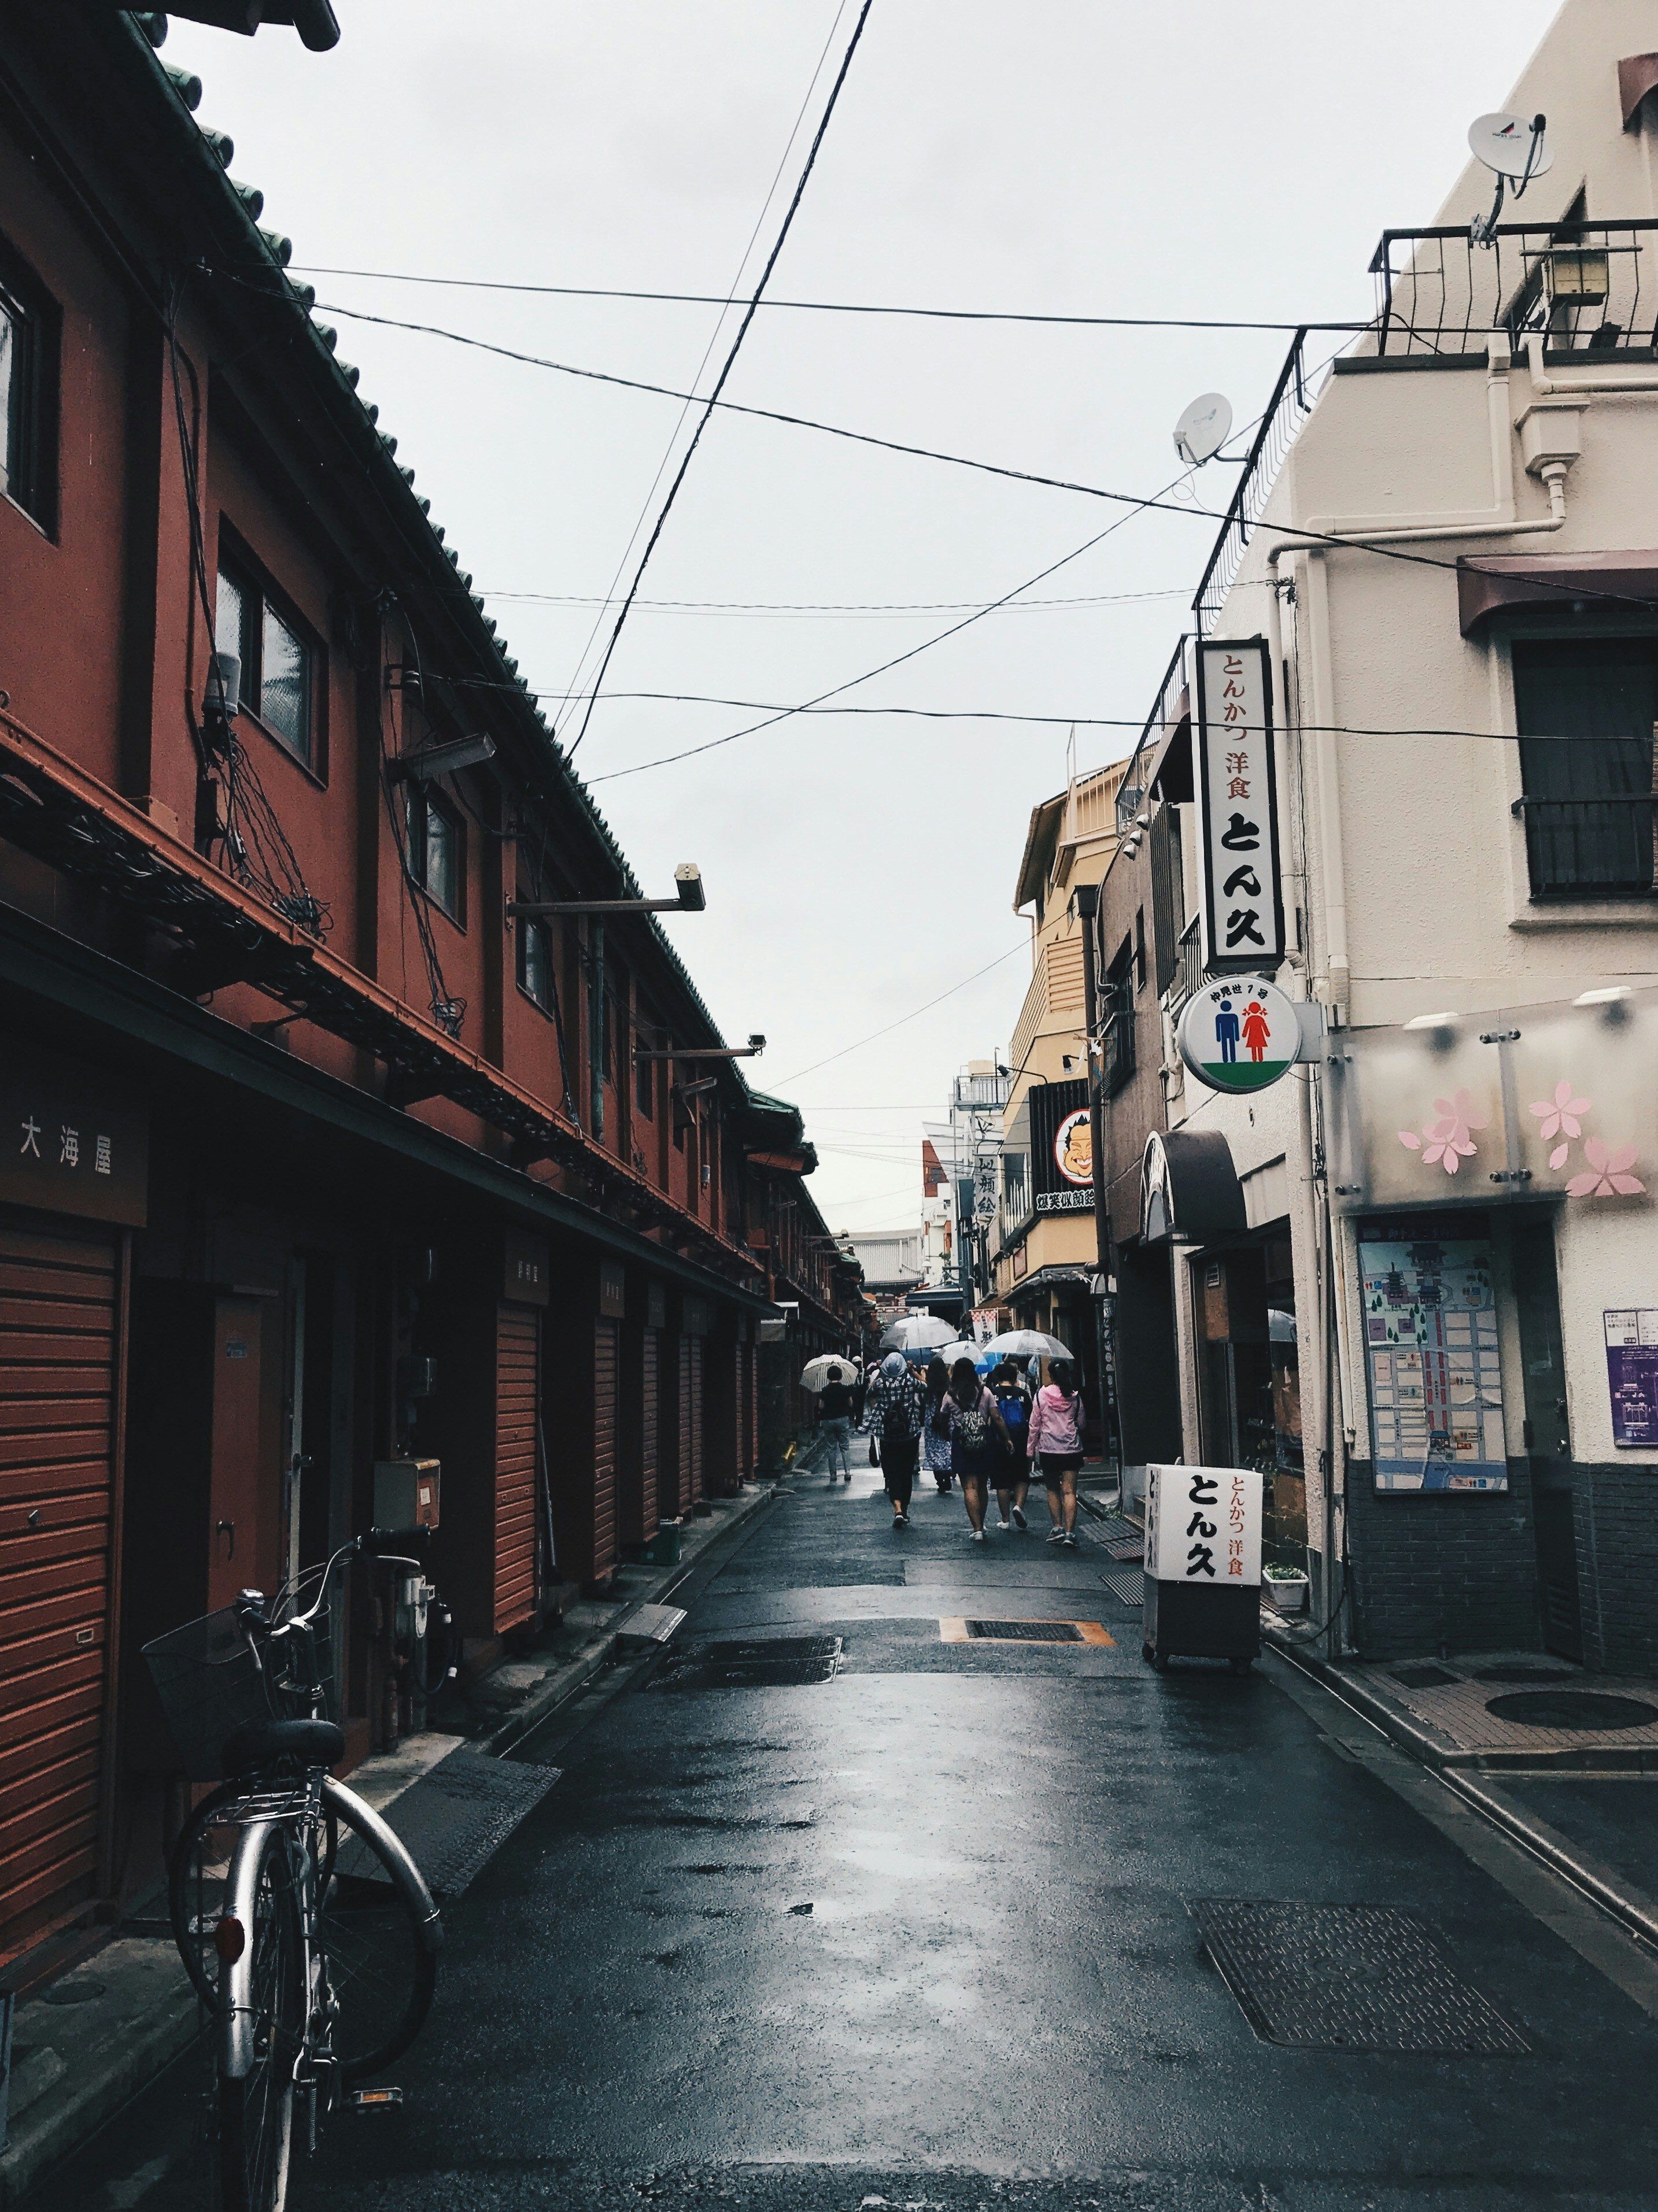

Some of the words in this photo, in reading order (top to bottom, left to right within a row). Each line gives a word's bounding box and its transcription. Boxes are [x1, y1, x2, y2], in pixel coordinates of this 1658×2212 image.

[1223, 654, 1247, 741] とんかつ
[1225, 752, 1251, 800] 洋食
[1221, 812, 1265, 948] とん久
[21, 1115, 111, 1175] 大海屋
[1187, 1475, 1218, 1577] とん久
[1229, 1477, 1245, 1533] とんかつ
[1228, 1539, 1244, 1576] 洋食
